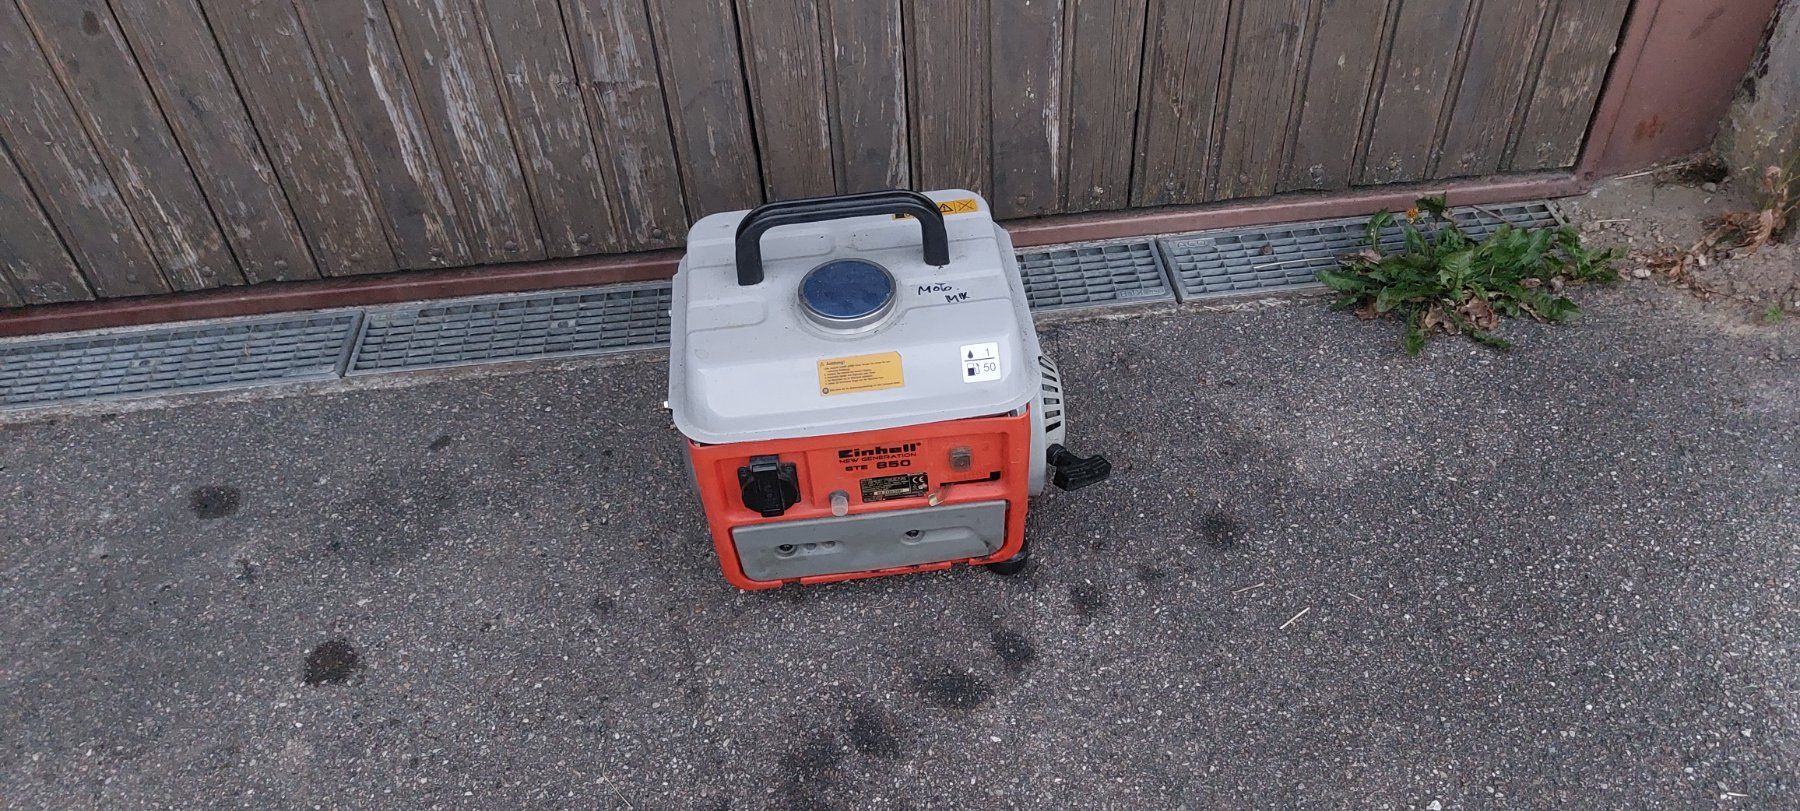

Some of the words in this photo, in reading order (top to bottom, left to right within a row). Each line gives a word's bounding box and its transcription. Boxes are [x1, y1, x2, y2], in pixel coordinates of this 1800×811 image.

[985, 347, 990, 357] 1
[983, 362, 997, 372] 50
[838, 443, 916, 458] Einhell
[862, 452, 917, 462] GENERATION
[876, 460, 911, 469] 850
[912, 476, 924, 484] CE
